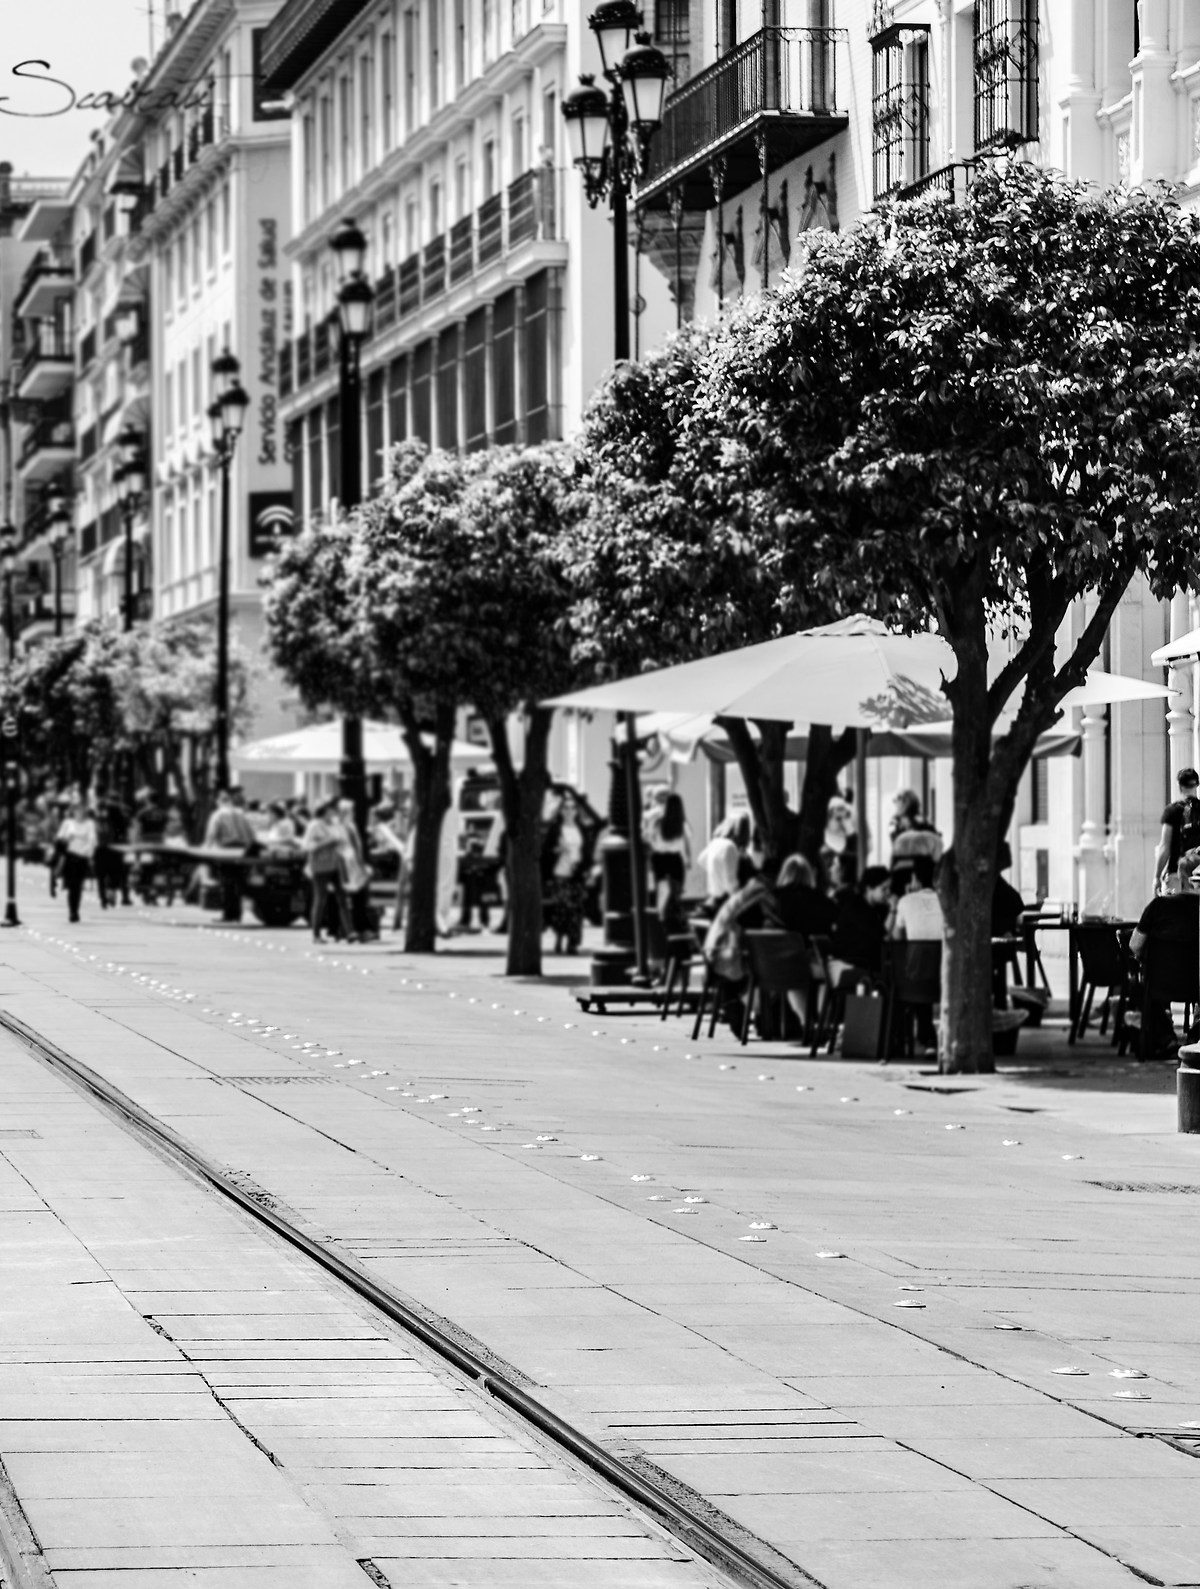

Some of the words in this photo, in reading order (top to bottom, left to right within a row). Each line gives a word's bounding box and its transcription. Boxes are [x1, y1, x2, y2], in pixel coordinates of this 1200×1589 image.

[257, 217, 277, 270] Salud
[259, 276, 277, 303] de
[258, 308, 277, 386] Andaluz
[258, 393, 277, 466] Servicio
